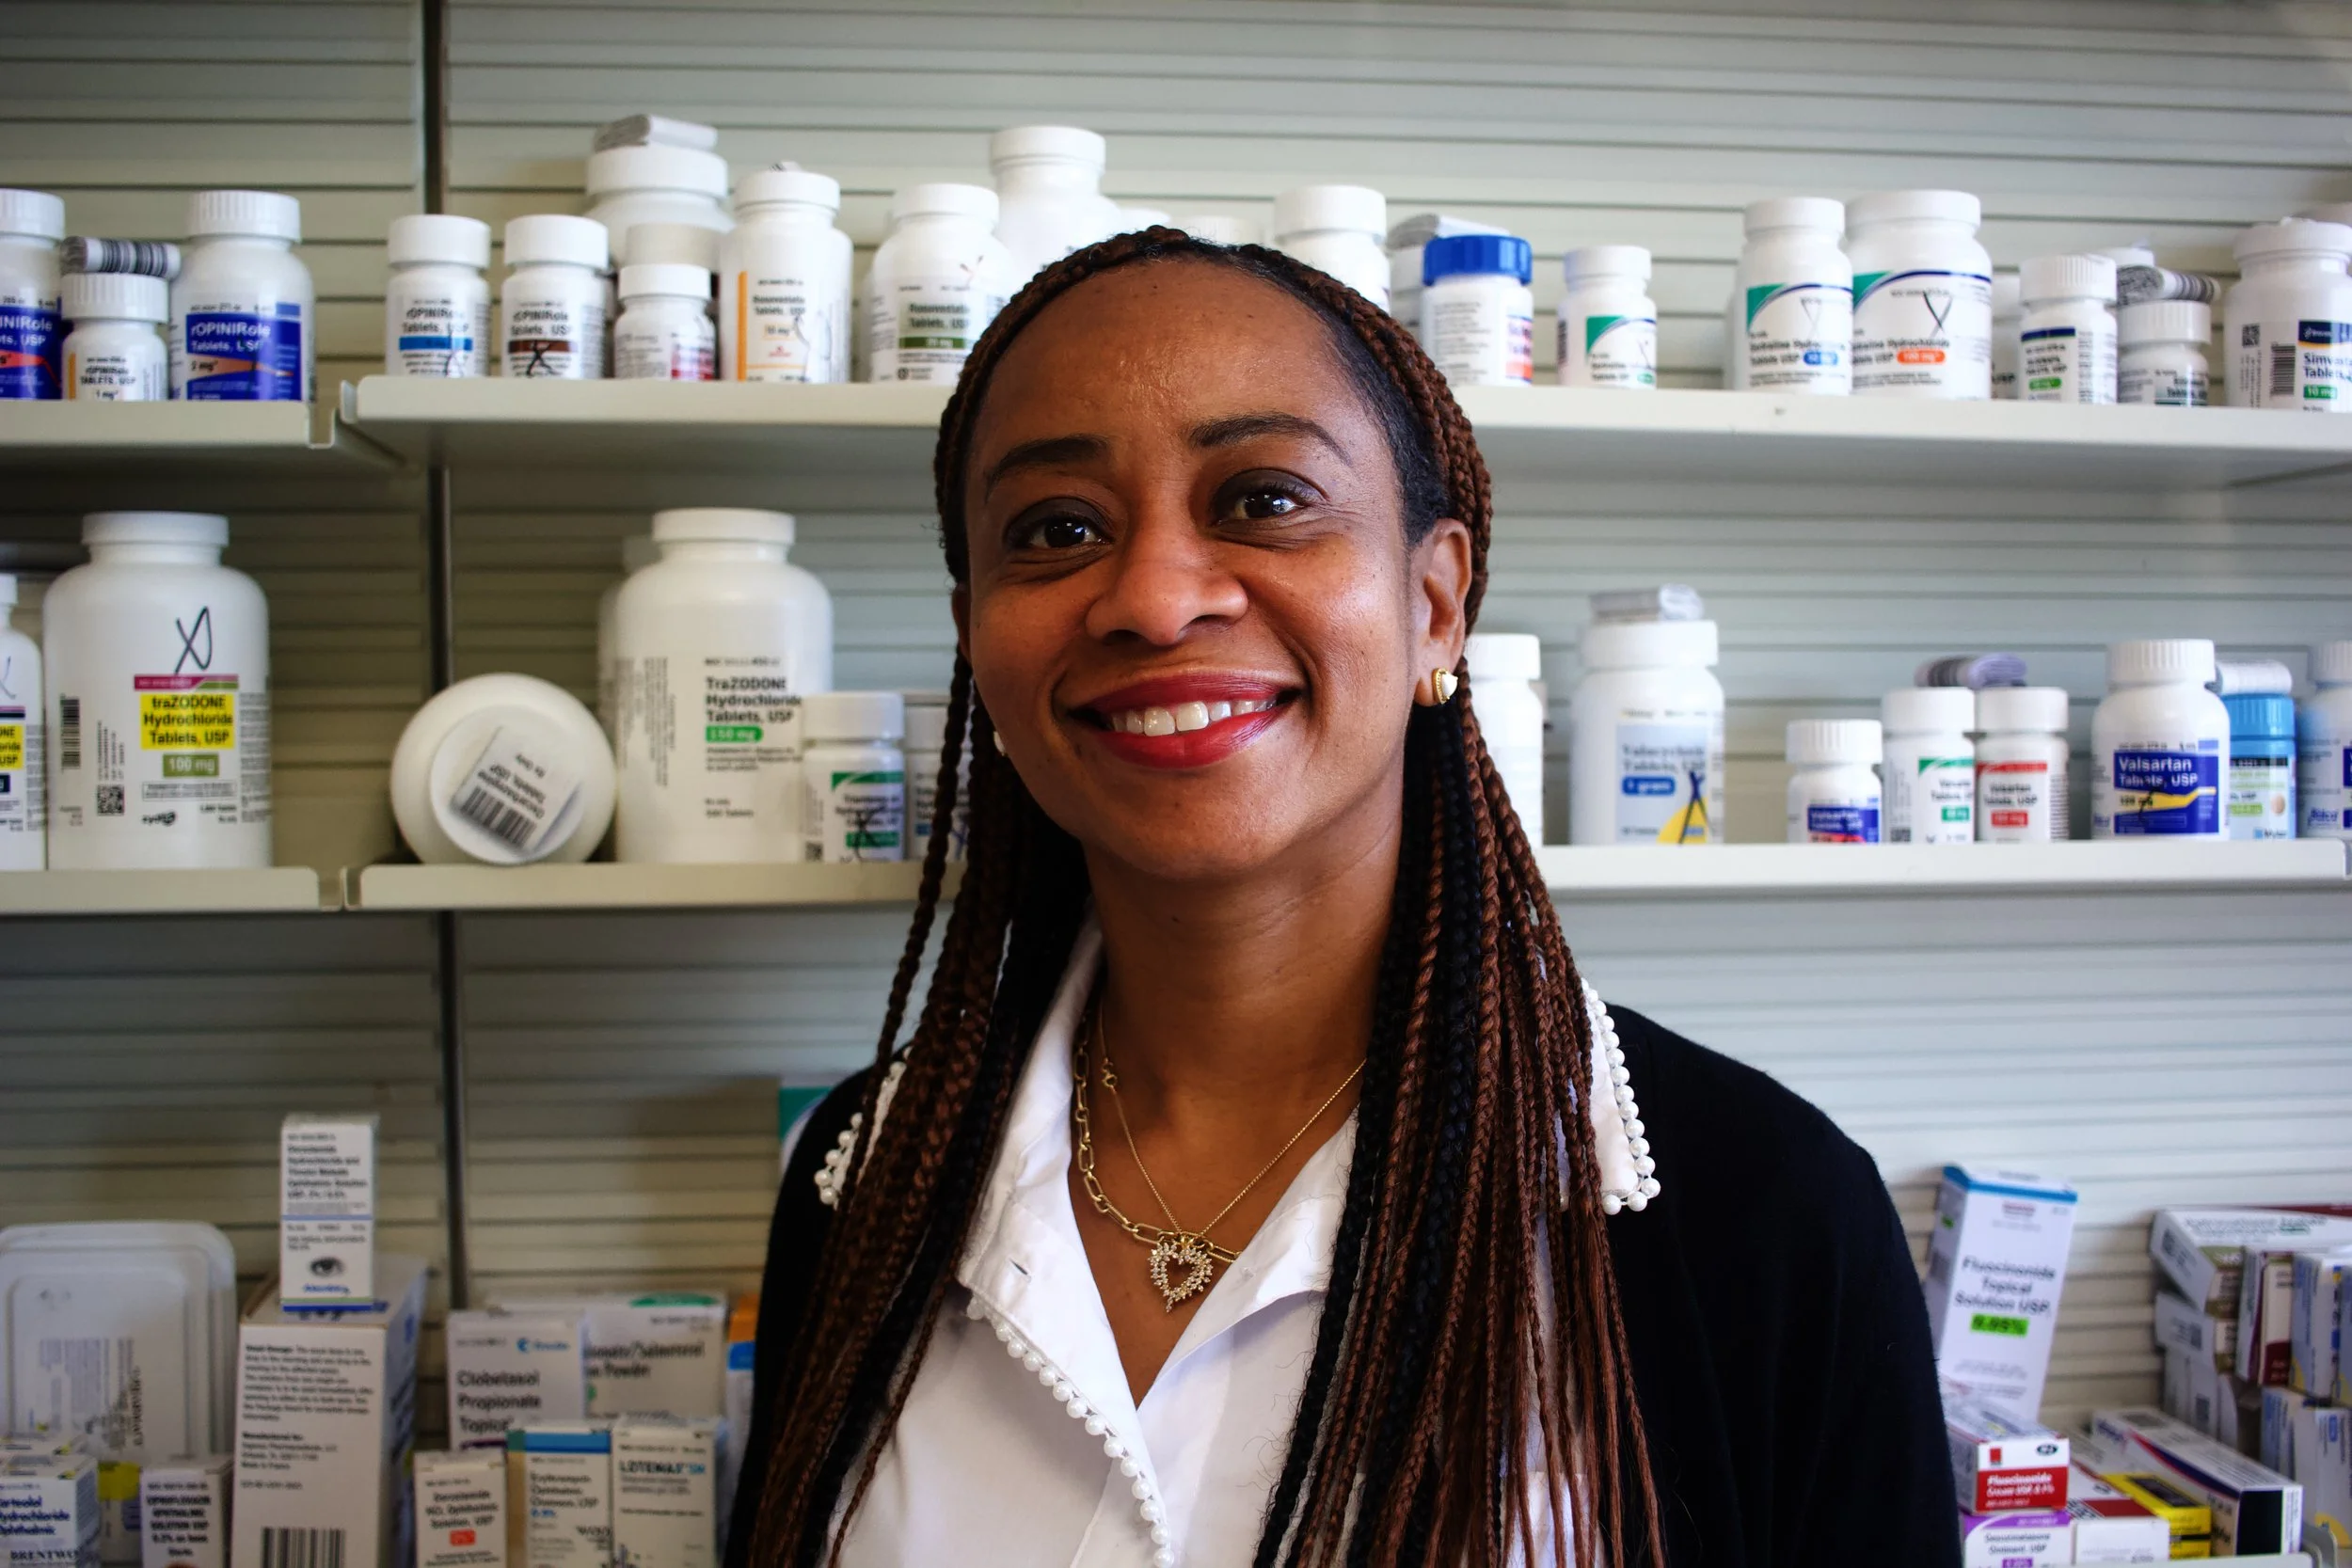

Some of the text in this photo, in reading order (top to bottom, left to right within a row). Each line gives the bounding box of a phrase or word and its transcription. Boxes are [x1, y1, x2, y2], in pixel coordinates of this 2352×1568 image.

[0, 315, 54, 331] INIRole
[191, 321, 271, 337] rOPINIRole
[0, 334, 46, 346] ts, USP
[152, 695, 226, 708] traZODONE
[706, 694, 802, 708] Hydrochloride
[144, 712, 234, 729] Hydrochloride
[707, 710, 795, 724] Tablets, USP
[151, 729, 230, 746] Tablets, USP
[169, 755, 215, 775] 100 mg
[2118, 755, 2193, 772] Valsartan
[2120, 772, 2200, 789] Tablts, USP
[1963, 1255, 2055, 1279] Fluocinonide
[1983, 1276, 2032, 1295] Topical
[1956, 1291, 2050, 1315] Solution USP
[583, 1341, 706, 1359] ionate/Salmeterol
[456, 1370, 540, 1386] Clobetasol
[458, 1393, 542, 1411] Propionate
[1986, 1473, 2053, 1487] Fluocinonide
[0, 1495, 42, 1508] arteolol
[0, 1509, 70, 1525] ydrochloride
